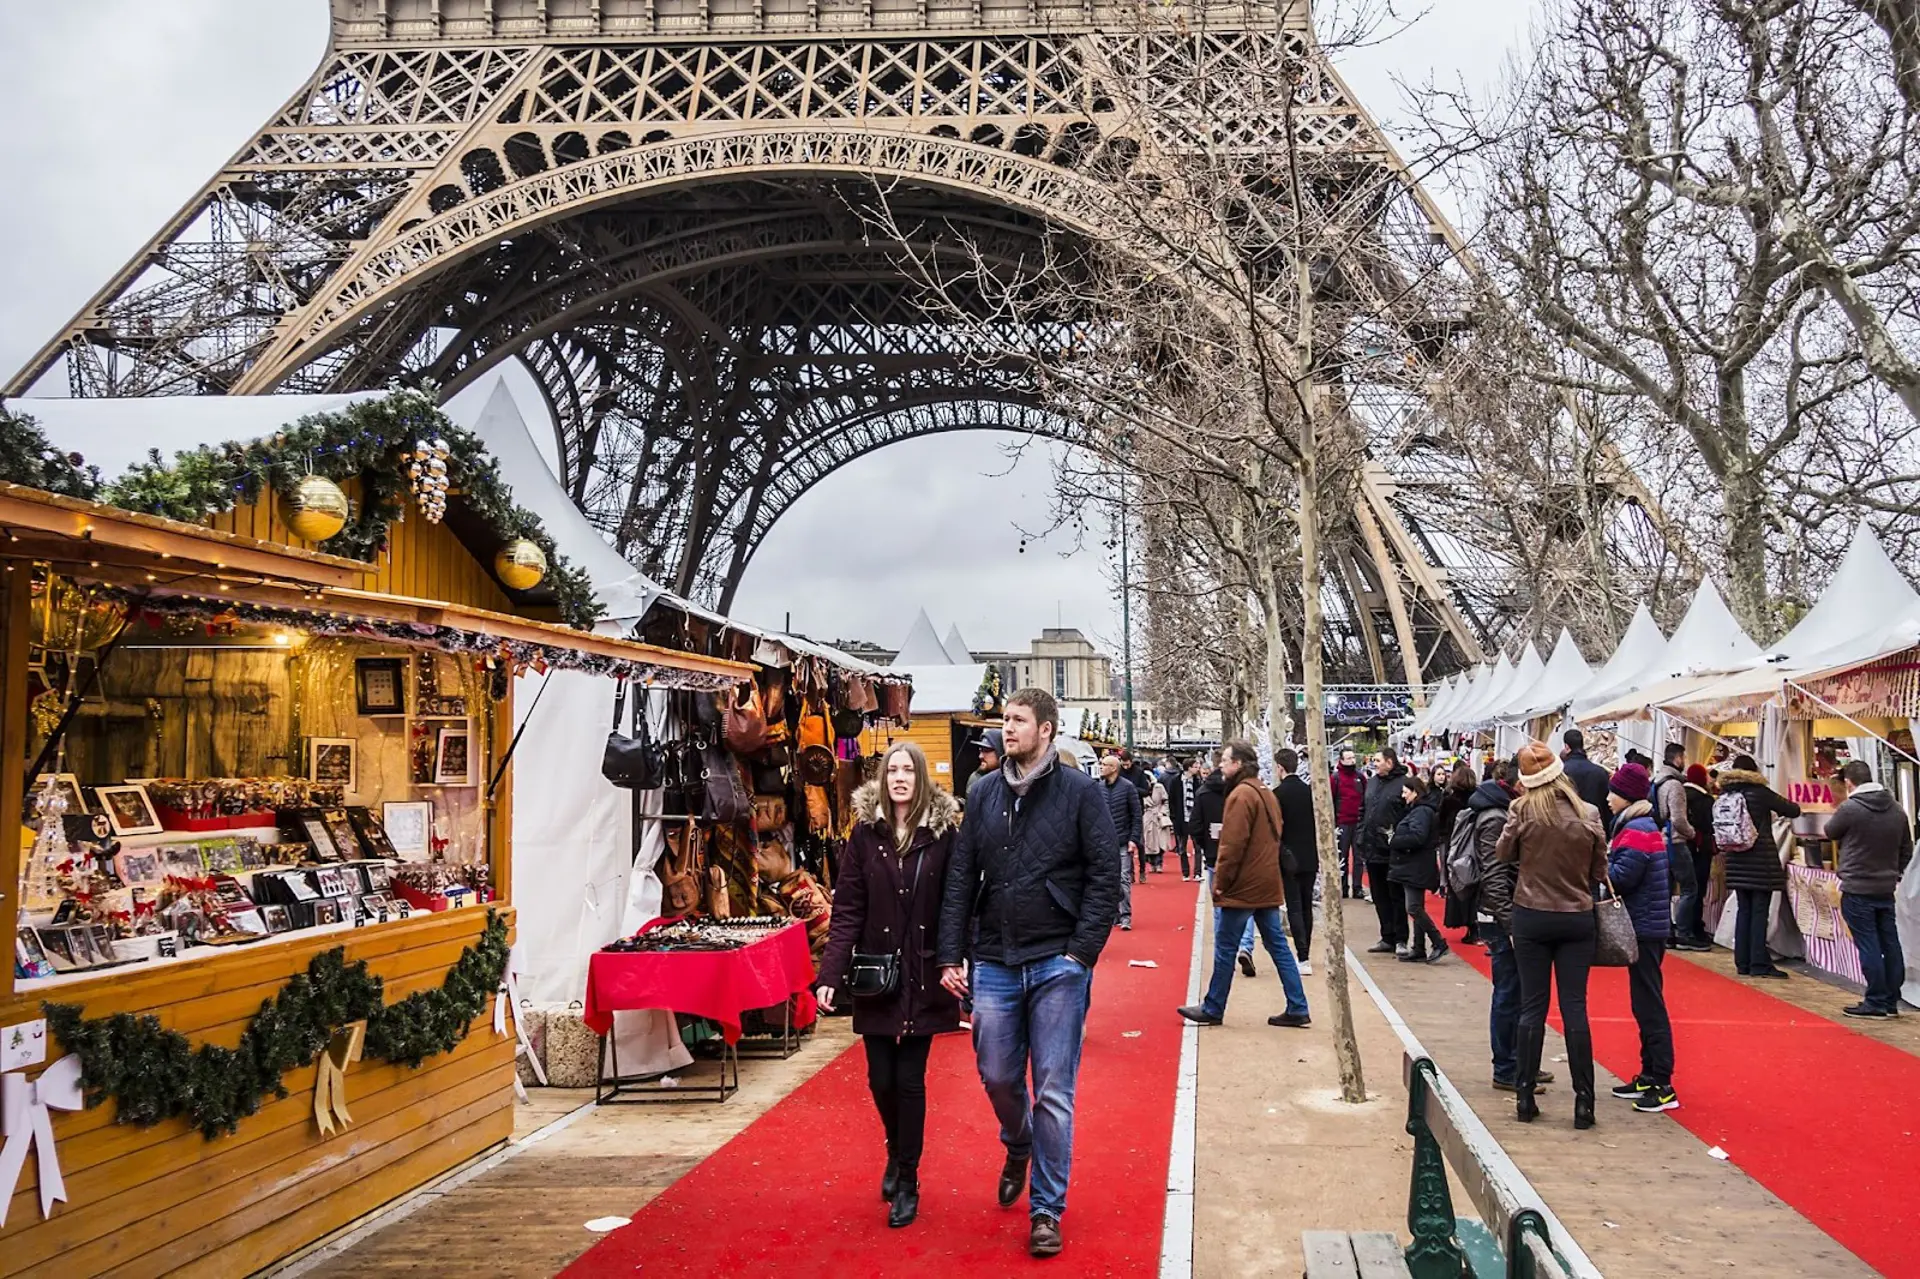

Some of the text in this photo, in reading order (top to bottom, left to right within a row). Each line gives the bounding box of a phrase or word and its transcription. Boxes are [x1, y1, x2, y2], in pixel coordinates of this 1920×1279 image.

[713, 15, 754, 25] COULOMB
[767, 14, 806, 24] POINSOT
[935, 10, 968, 20] MORIN
[614, 17, 640, 26] VICAT
[659, 16, 700, 26] EBELMEN
